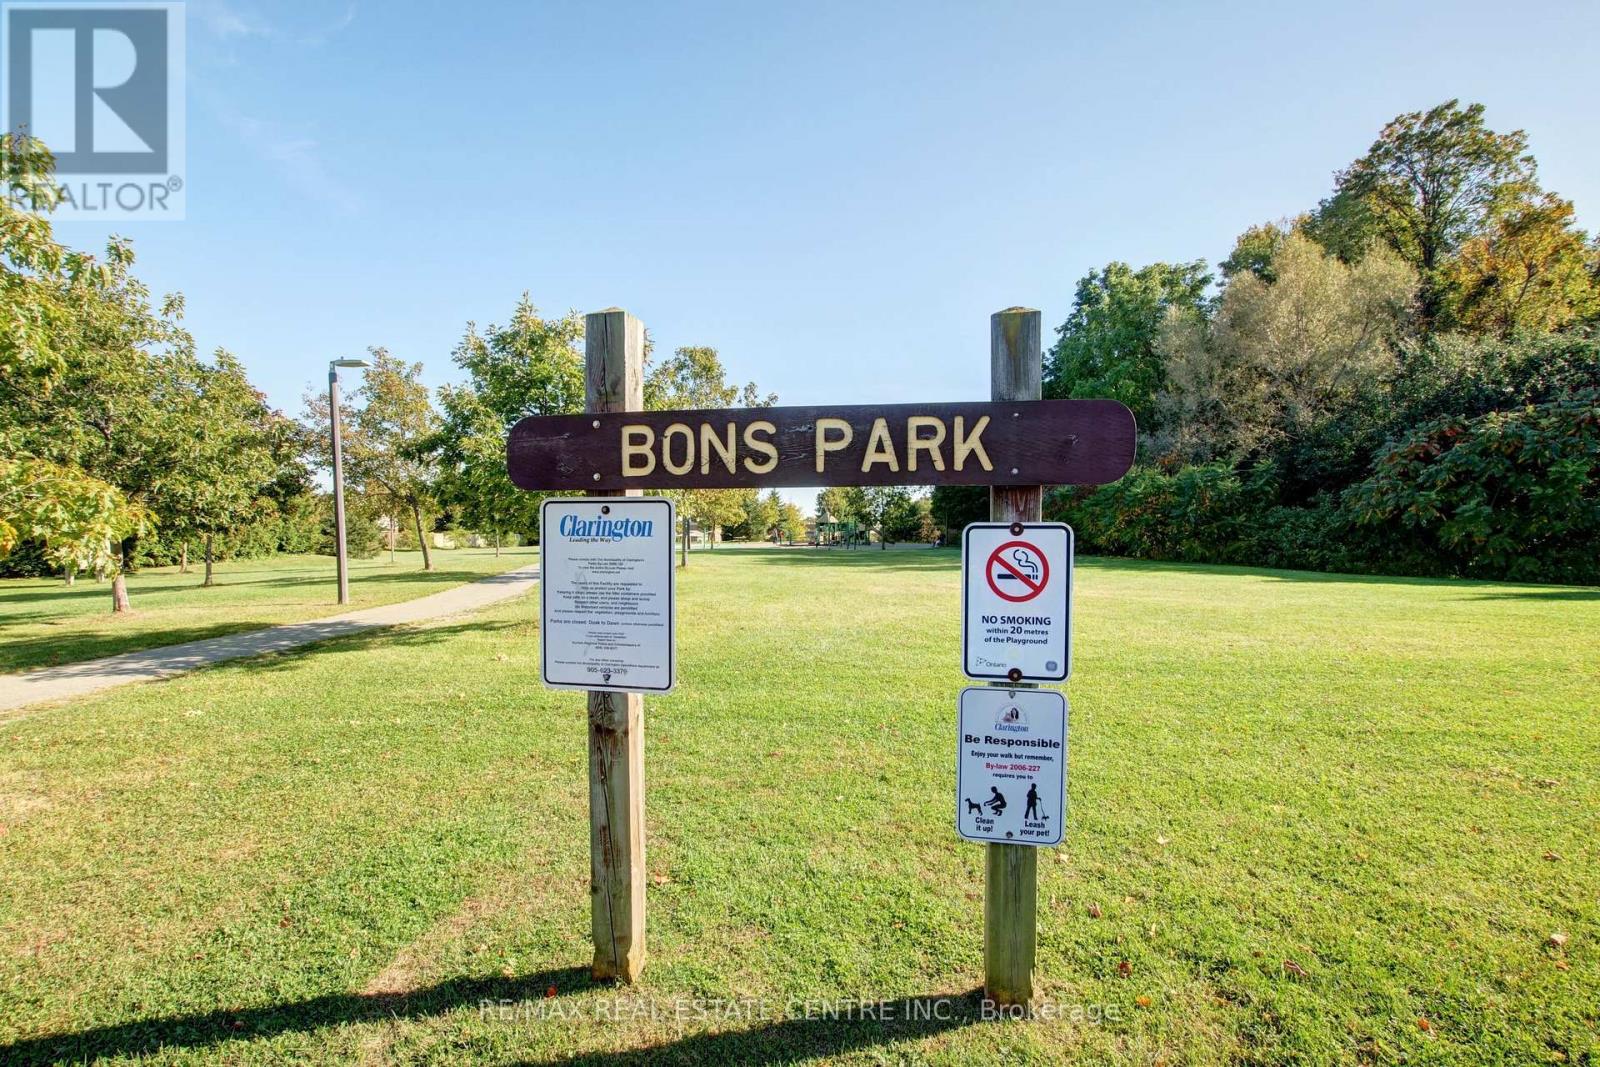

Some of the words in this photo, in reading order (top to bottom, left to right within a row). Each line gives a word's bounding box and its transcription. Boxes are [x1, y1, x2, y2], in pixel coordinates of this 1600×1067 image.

[621, 421, 778, 477] BONS
[815, 415, 994, 473] PARK
[560, 514, 654, 542] Clarington
[982, 615, 998, 624] NO
[1000, 616, 1051, 626] SMOKING
[1010, 626, 1022, 634] 20
[1006, 636, 1048, 645] Playground
[994, 723, 1029, 732] Clarington
[964, 734, 980, 744] Be
[984, 735, 1060, 748] Responsible
[971, 750, 985, 758] Enjoy
[1024, 754, 1054, 762] remember,
[985, 762, 1008, 770] By-law
[975, 816, 994, 825] Clean
[1024, 820, 1045, 828] Leash
[1036, 829, 1050, 837] pet!
